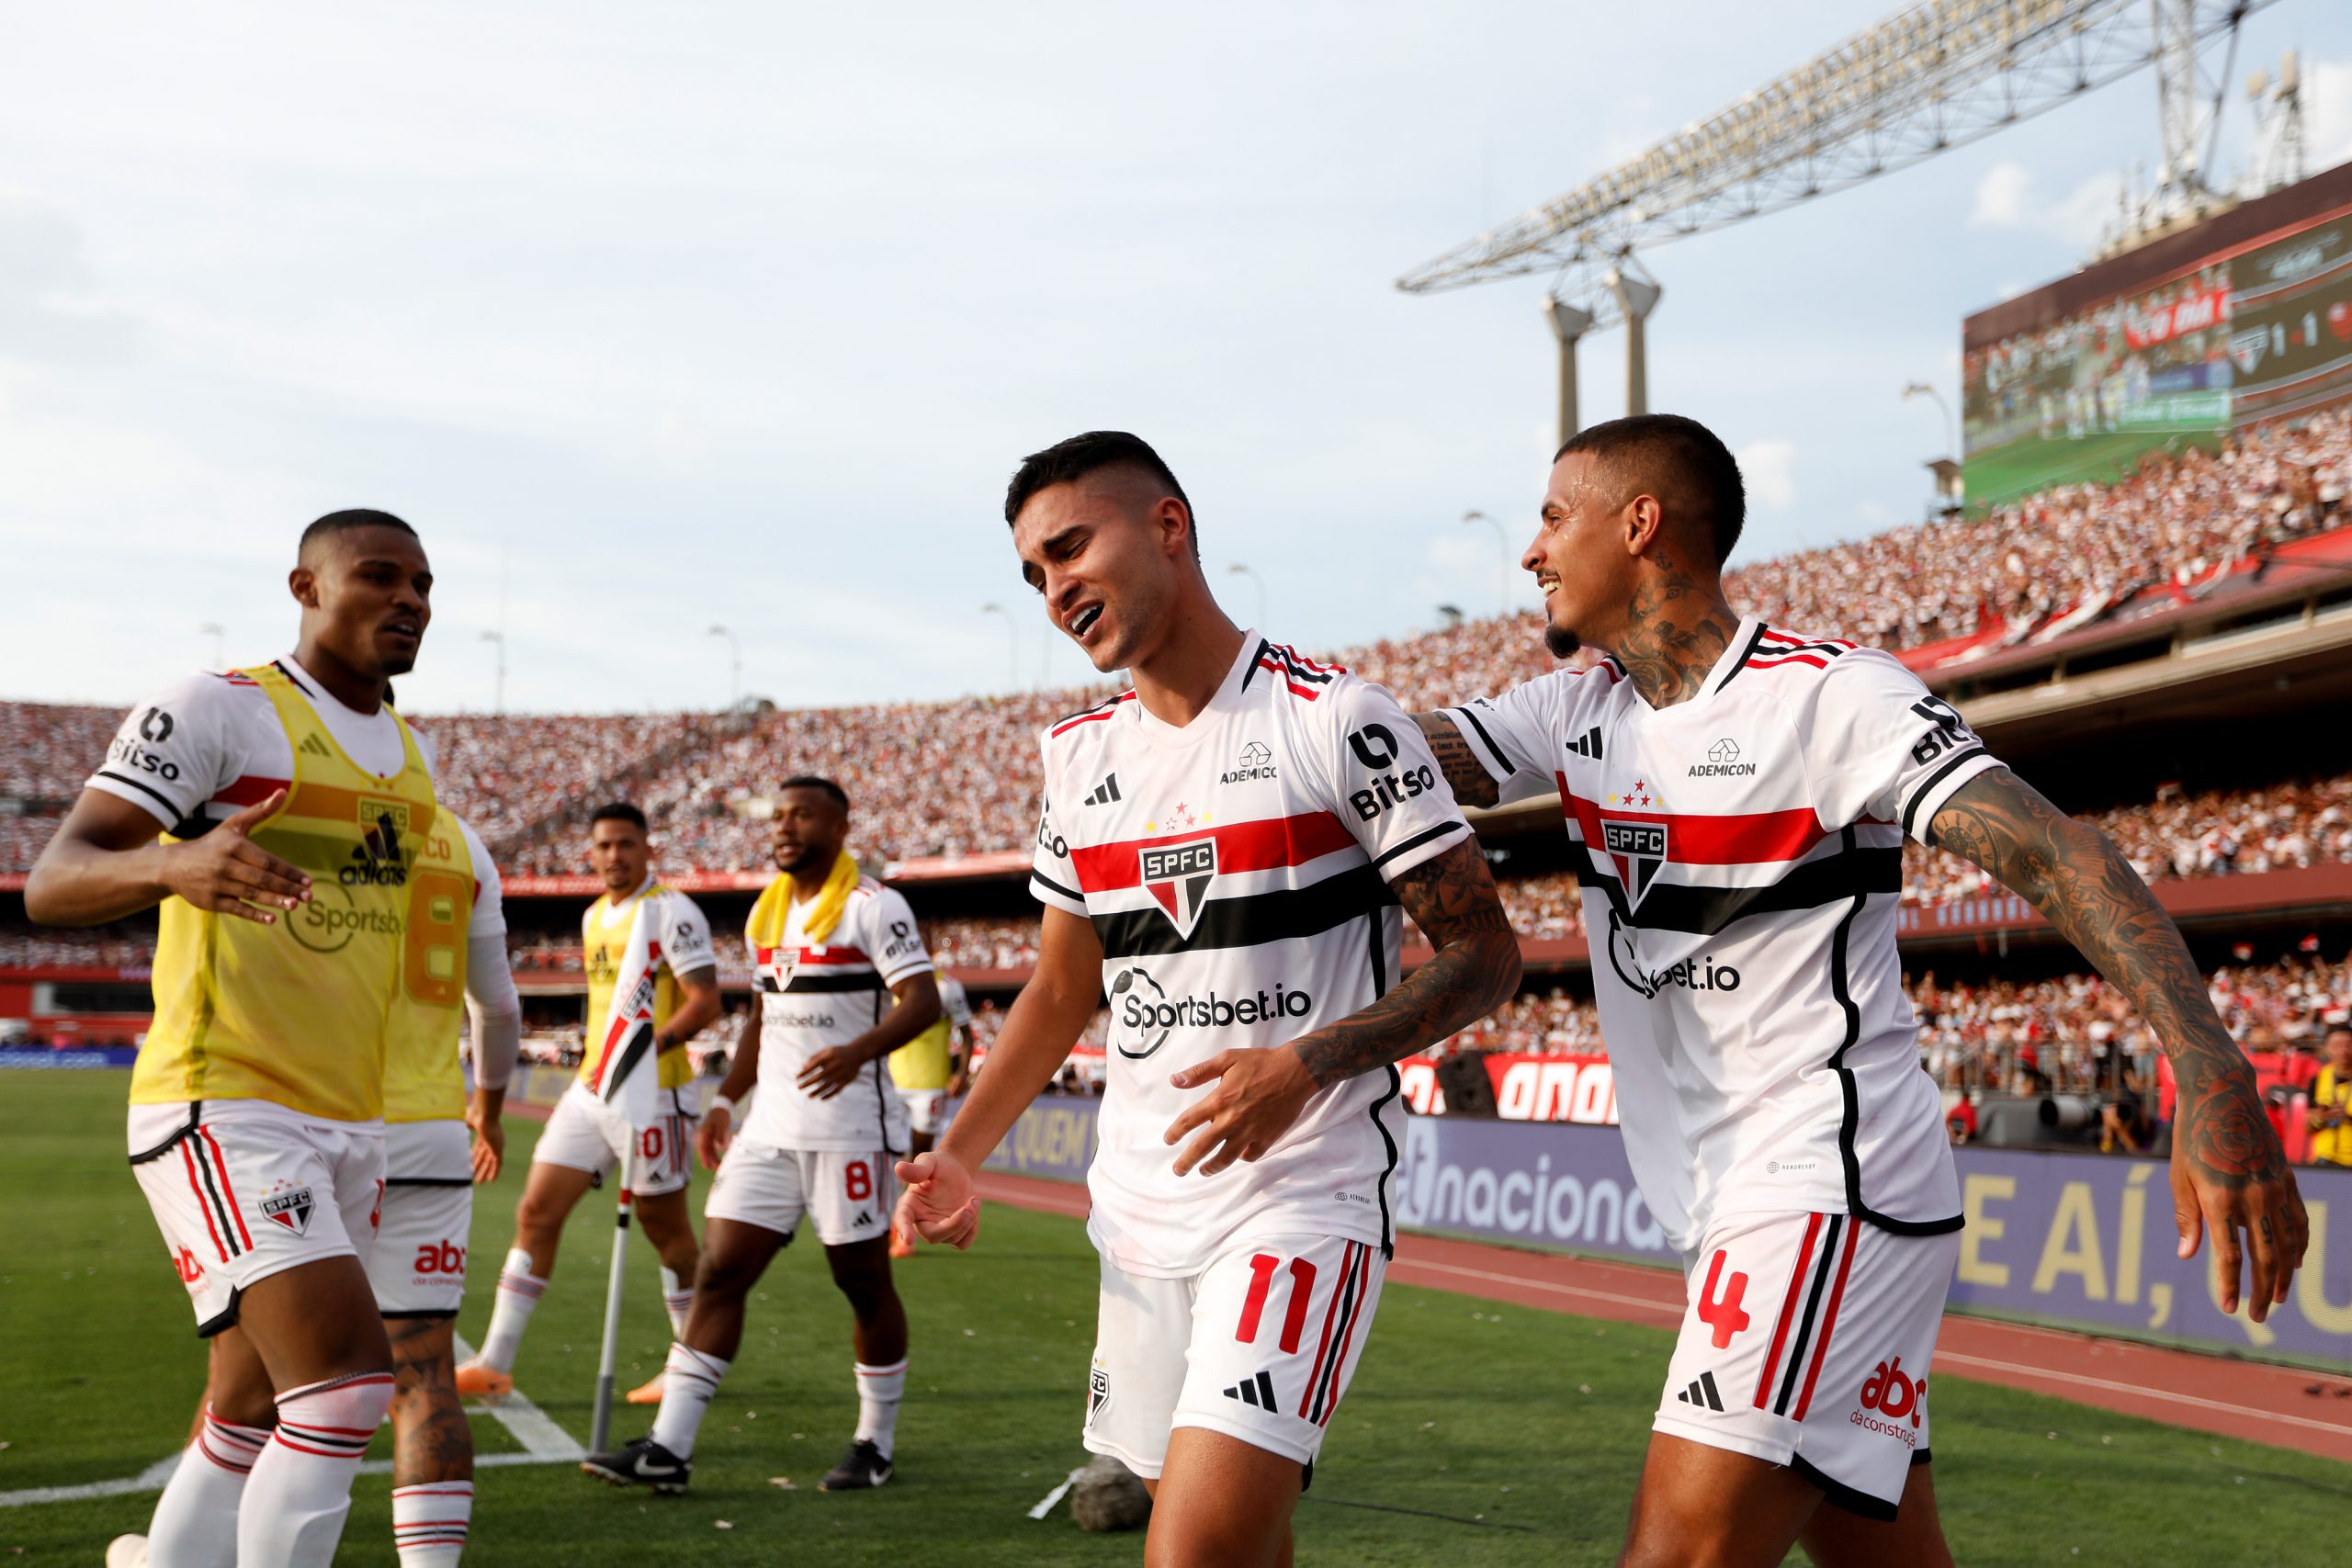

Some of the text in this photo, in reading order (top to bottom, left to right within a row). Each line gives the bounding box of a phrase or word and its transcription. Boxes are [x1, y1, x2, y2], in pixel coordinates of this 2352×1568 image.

[1349, 764, 1435, 822] Bitso
[1688, 763, 1756, 777] ADEMICON
[1147, 847, 1210, 876] SPFC
[1606, 828, 1662, 852] SPFC
[1123, 982, 1312, 1038] Sportsbet.io
[844, 1159, 872, 1202] 8
[1957, 1173, 2017, 1287] E
[2030, 1163, 2173, 1329] AÍ,
[1235, 1254, 1317, 1355] 11
[1698, 1249, 1751, 1349] 4
[1860, 1355, 1928, 1429] abc
